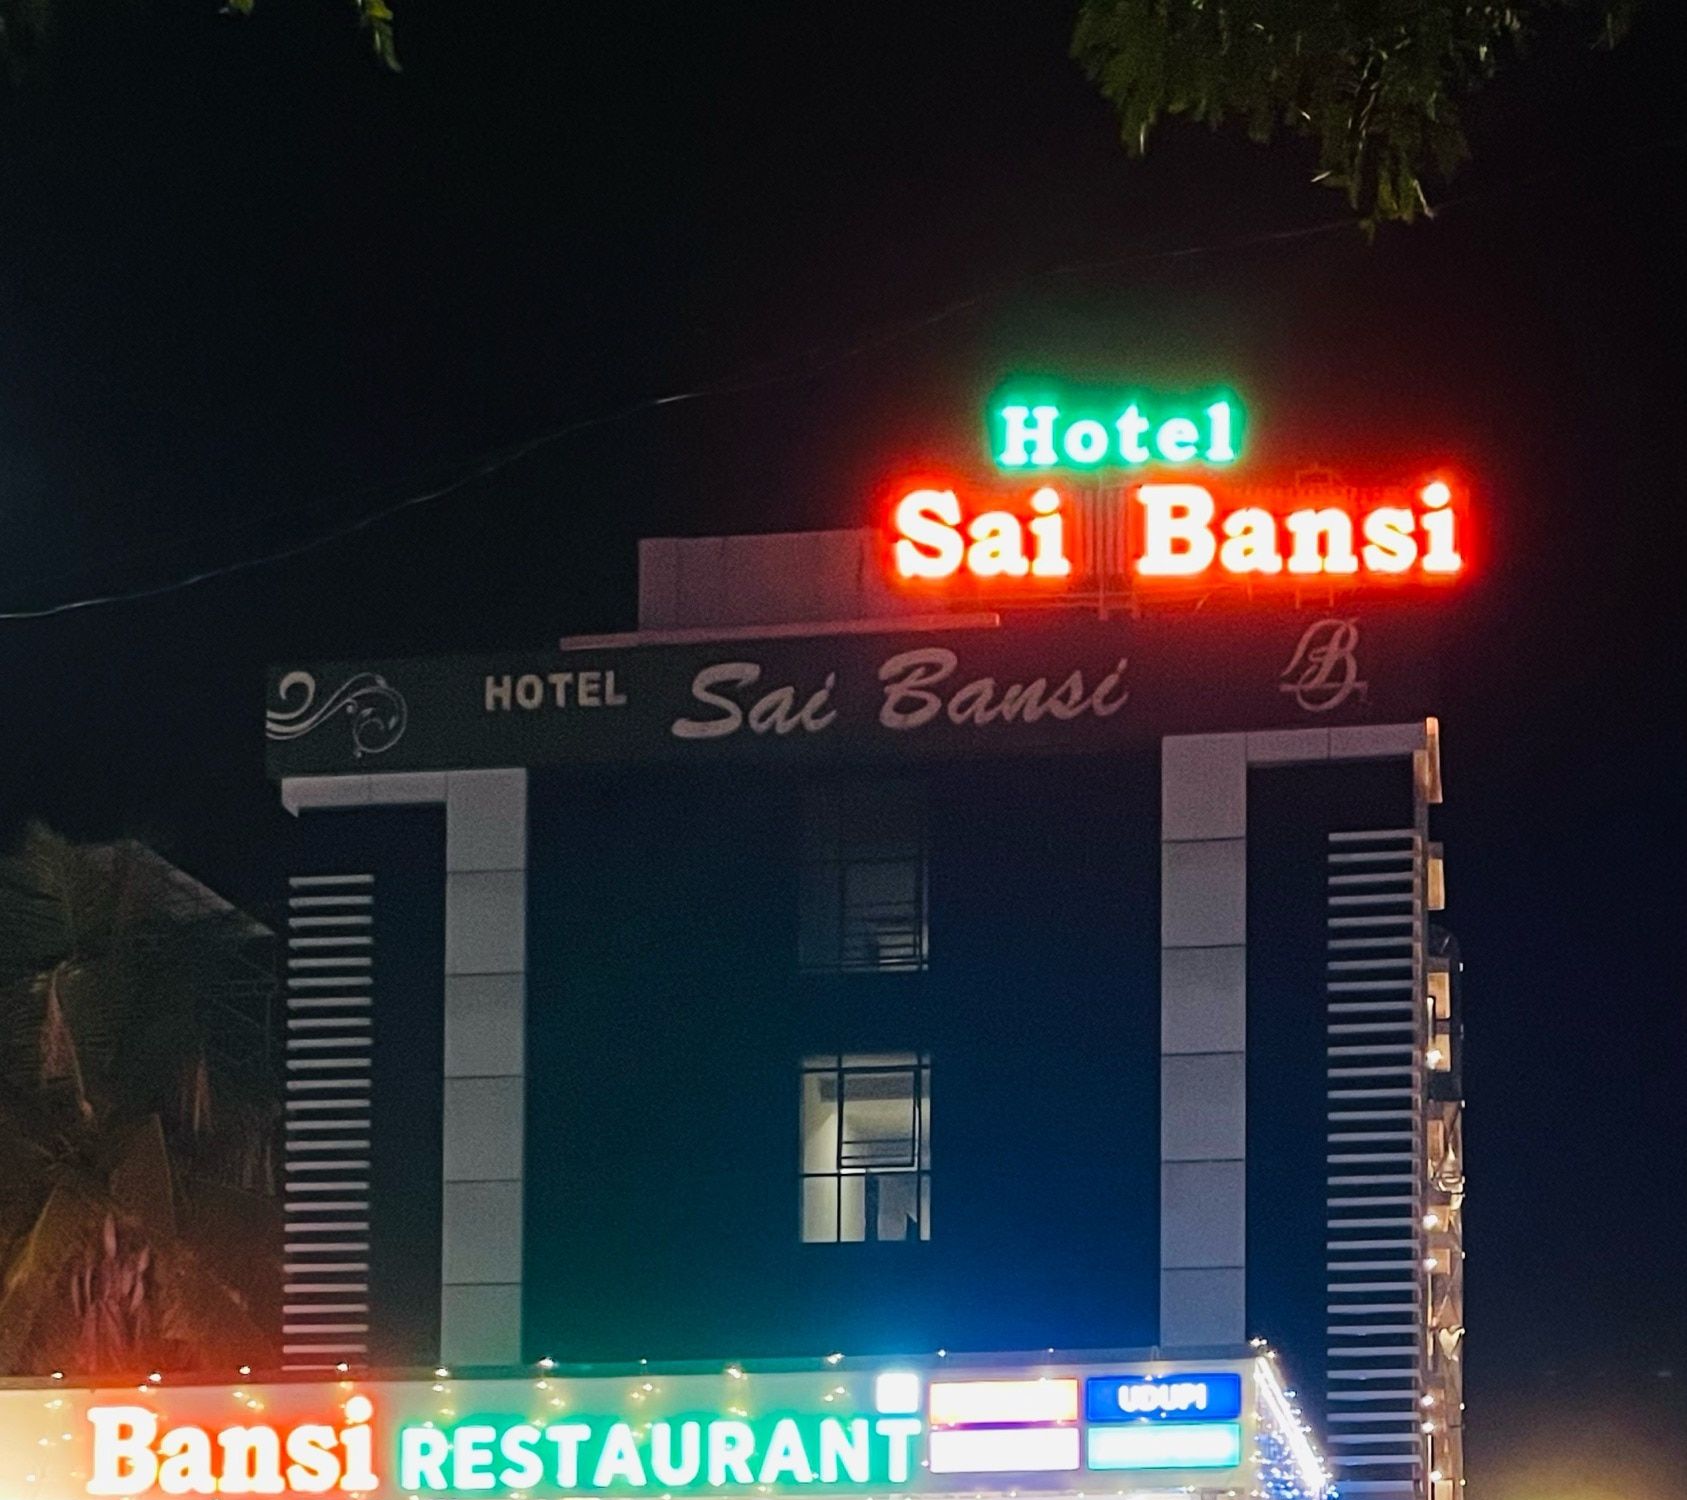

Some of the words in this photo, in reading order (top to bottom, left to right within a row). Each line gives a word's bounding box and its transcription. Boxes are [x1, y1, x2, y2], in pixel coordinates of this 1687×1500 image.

[999, 401, 1236, 466] Hotel
[896, 487, 1071, 578] Sai
[1136, 481, 1462, 575] Bansi
[485, 670, 628, 712] HOTEL
[671, 662, 838, 738] Sai
[878, 648, 1129, 730] Bansi
[1118, 1383, 1207, 1413] UDUPI
[86, 1396, 378, 1495] Bansi
[401, 1419, 922, 1490] RESTAURANT
